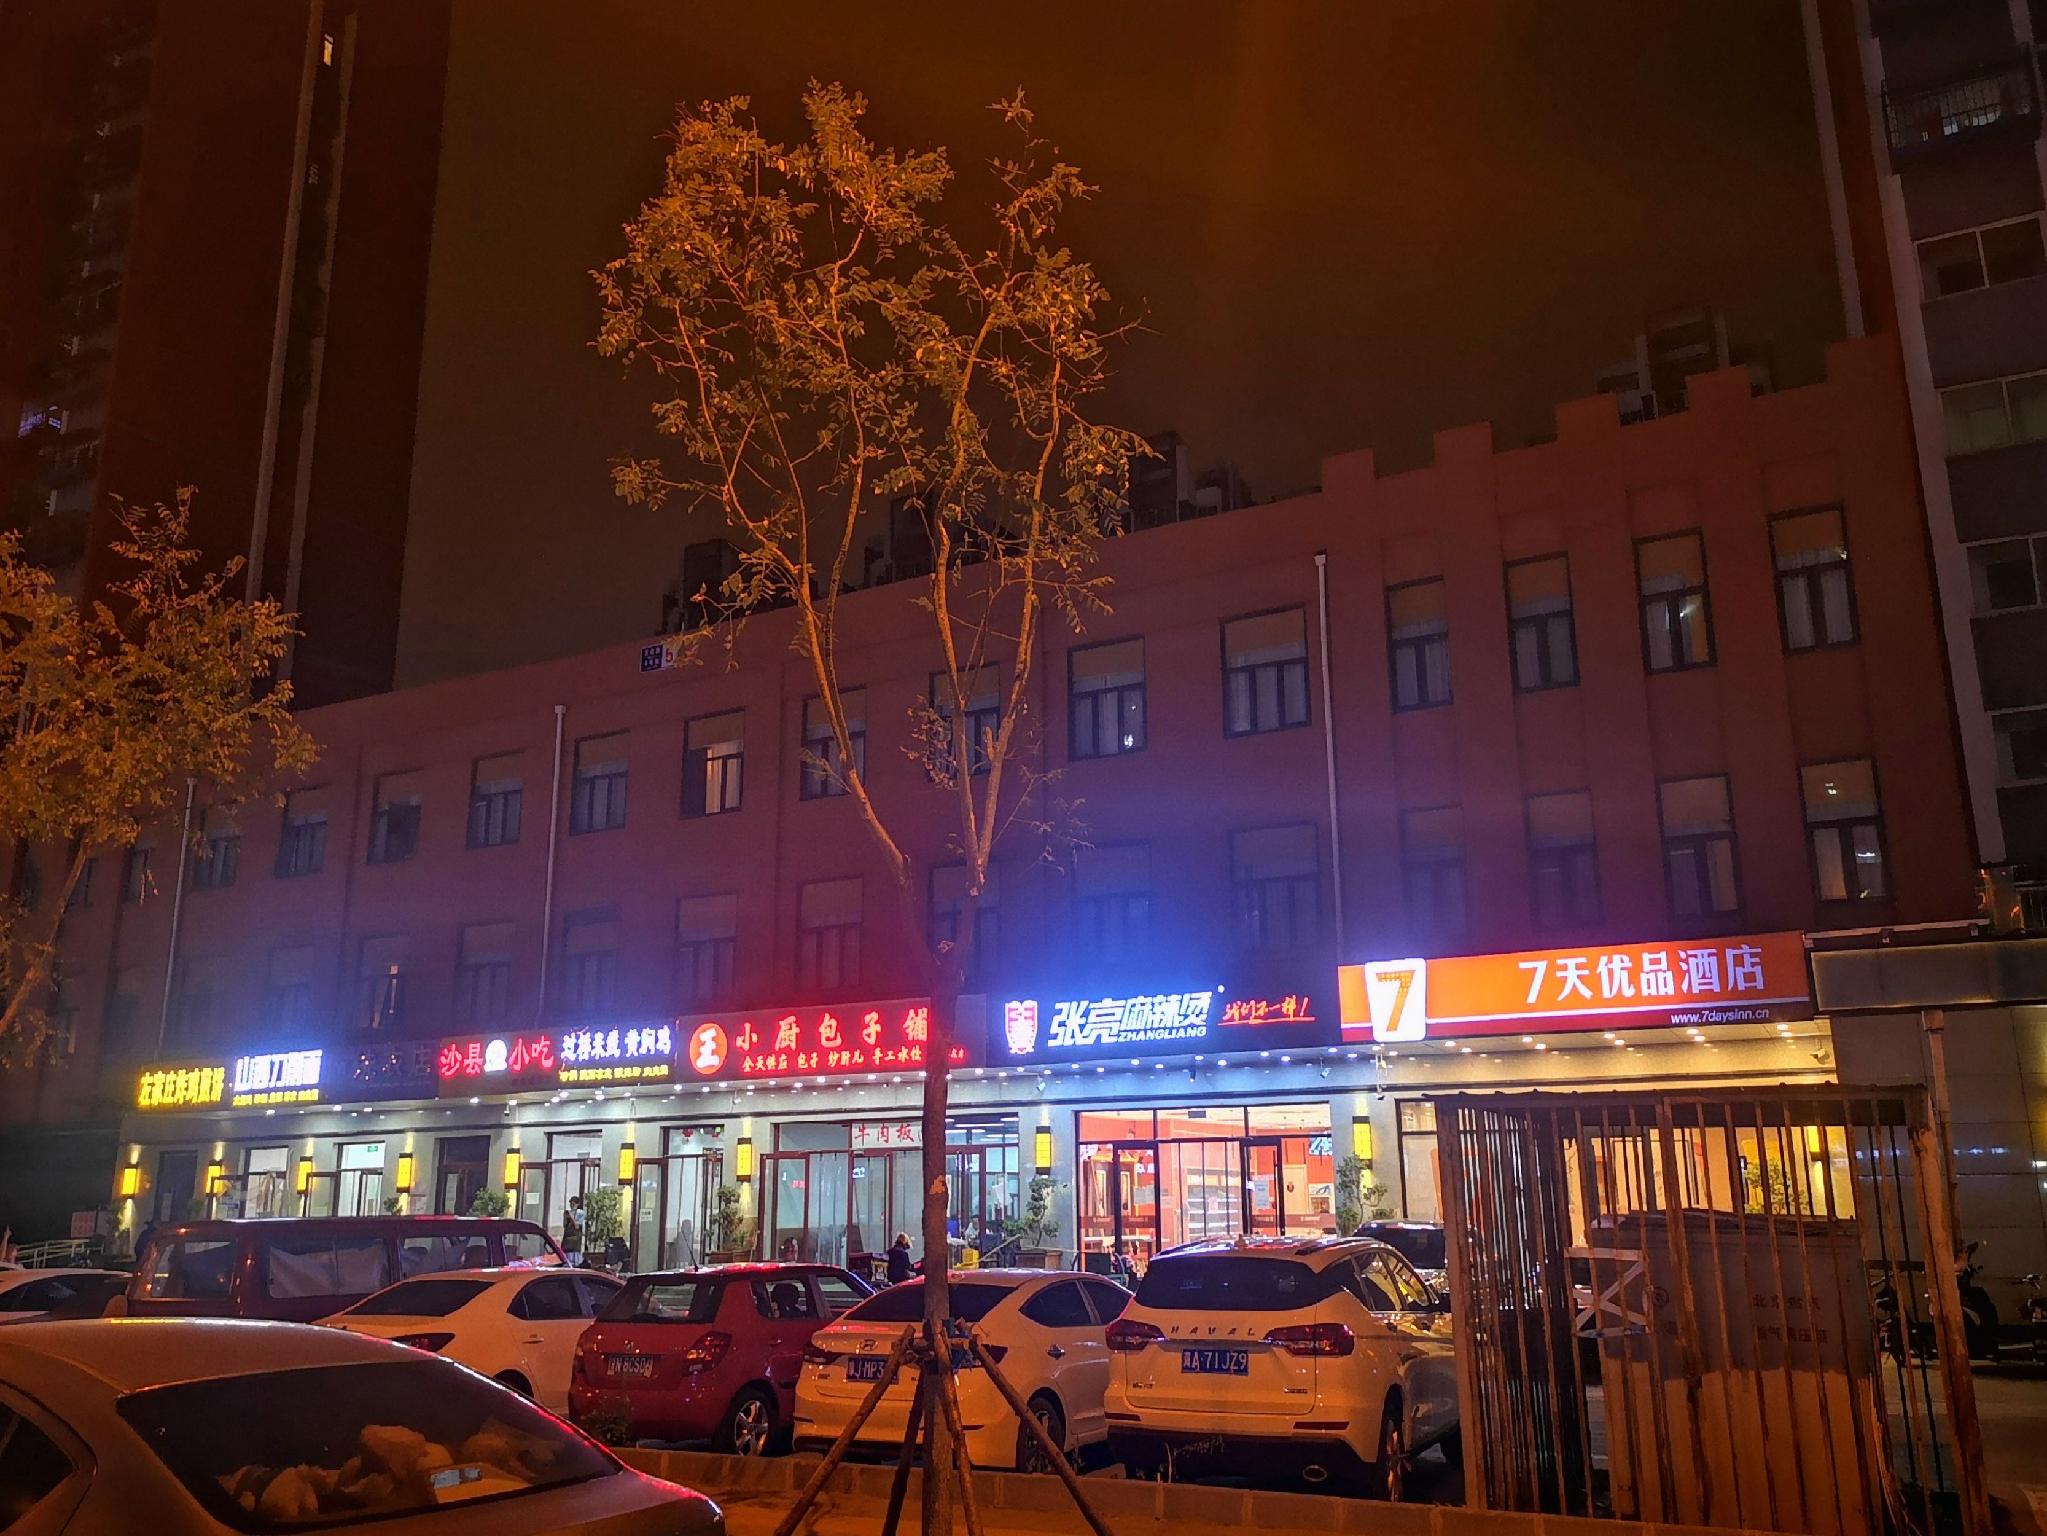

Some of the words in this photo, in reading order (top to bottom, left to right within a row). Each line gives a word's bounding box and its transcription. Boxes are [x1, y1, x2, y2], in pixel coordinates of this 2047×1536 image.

[1518, 946, 1764, 1004] 7天优品酒店
[1376, 969, 1416, 1032] 7
[1671, 1008, 1769, 1024] www.7daysinn.cn
[736, 1007, 927, 1050] 小厨包子铺
[1048, 991, 1213, 1046] 张亮麻辣烫
[1117, 1026, 1207, 1042] ZHANGLIANG
[695, 1027, 720, 1068] 王
[797, 1051, 818, 1068] 包子
[854, 1122, 921, 1146] 牛肉板
[1170, 1325, 1256, 1337] HAVAL
